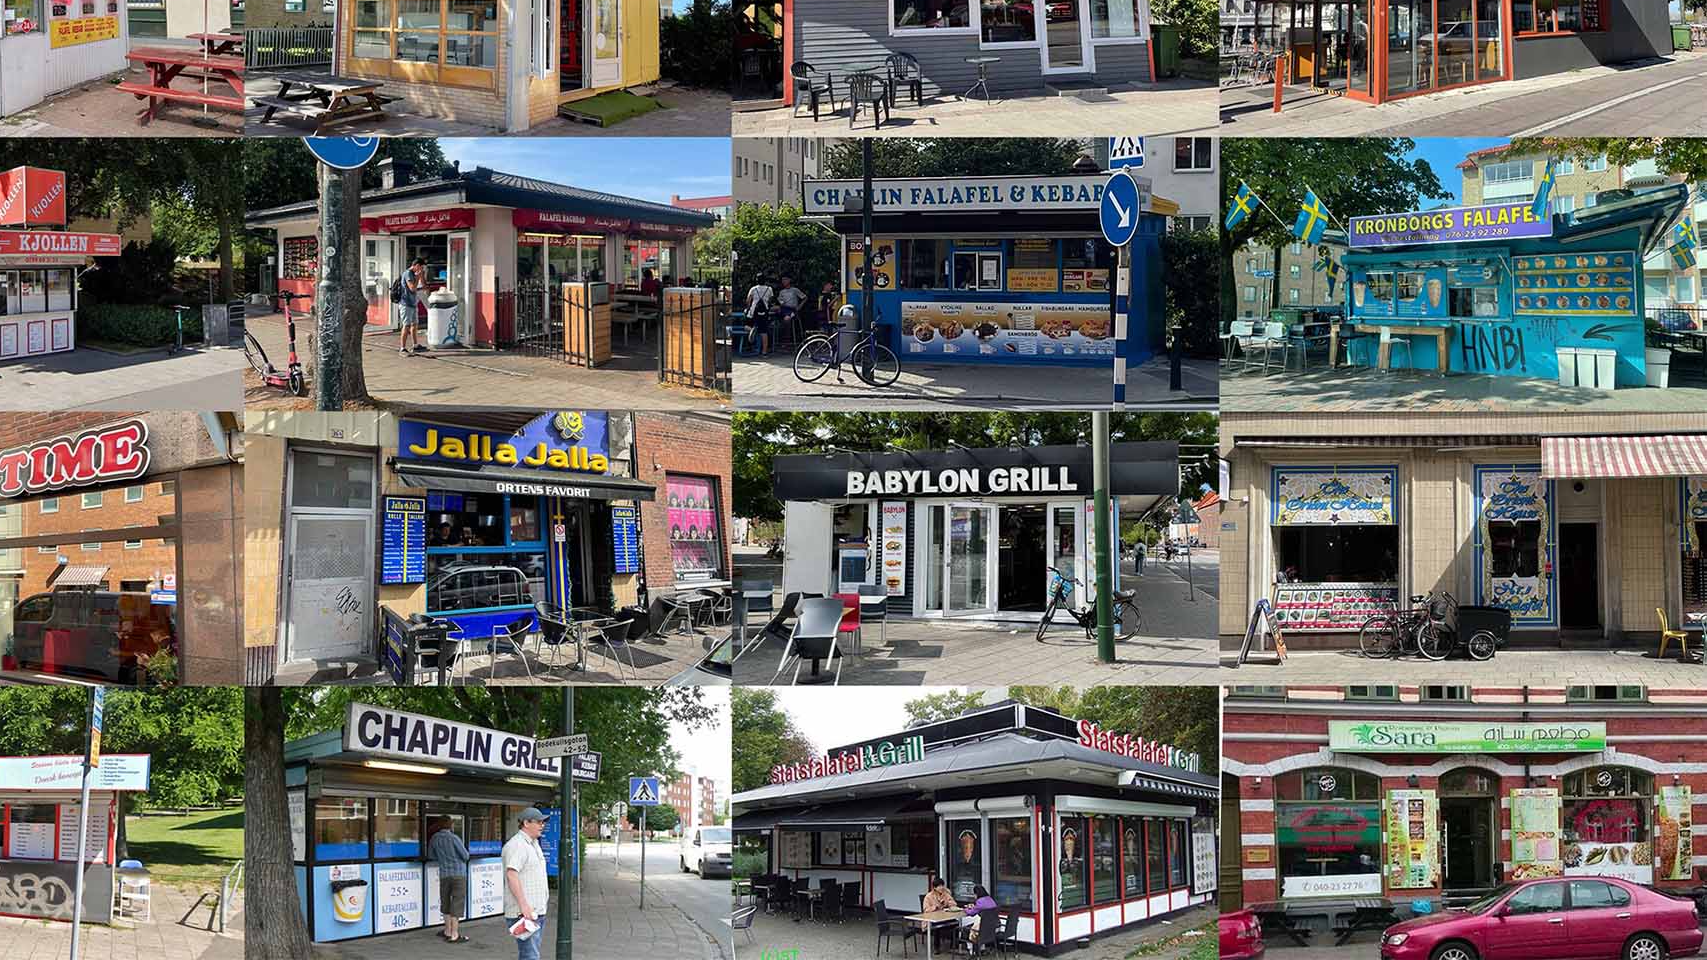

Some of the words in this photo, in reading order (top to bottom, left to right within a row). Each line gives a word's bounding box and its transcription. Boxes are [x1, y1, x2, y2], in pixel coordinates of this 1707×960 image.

[910, 185, 1004, 207] FALAFEL
[1009, 185, 1026, 203] &
[539, 212, 562, 223] FALAFEL
[561, 215, 586, 225] BAGHDAD
[1354, 213, 1454, 235] KRONBORGS
[19, 234, 89, 252] KJOLLEN
[408, 428, 519, 466] Jalla
[524, 441, 610, 474] Jalla
[495, 482, 544, 496] ORTENS
[545, 484, 592, 498] FAVORIT
[847, 468, 981, 496] BABYLON
[987, 466, 1079, 493] GRILL
[883, 505, 906, 514] BABYLON
[1285, 498, 1330, 512] Orient
[1331, 497, 1383, 512] House
[357, 710, 493, 764] CHAPLIN
[1076, 718, 1170, 768] Statsfalafel
[1176, 747, 1200, 773] Grill
[1370, 725, 1437, 746] Sara
[562, 745, 588, 755] 42-52
[771, 745, 865, 786] Statsfalafel
[875, 734, 926, 768] Grill
